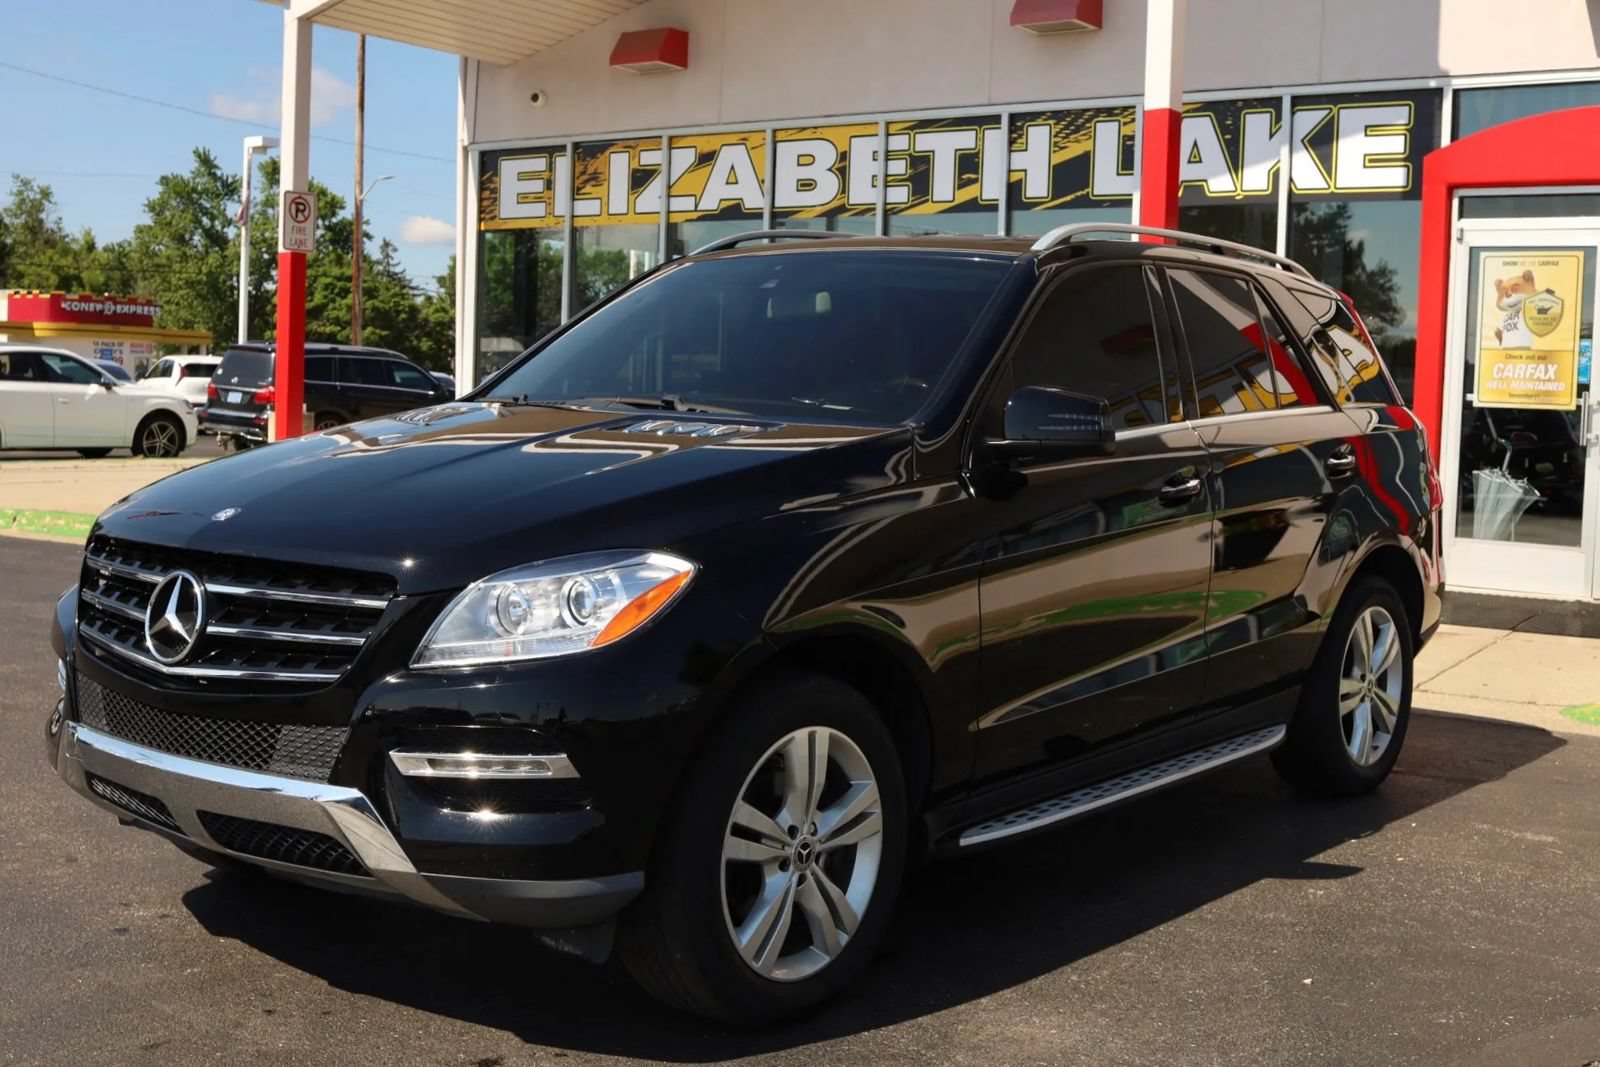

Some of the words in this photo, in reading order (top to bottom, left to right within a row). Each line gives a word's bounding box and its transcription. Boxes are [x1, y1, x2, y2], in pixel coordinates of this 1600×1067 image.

[499, 120, 1054, 220] ELIZABETH
[1090, 101, 1414, 199] LAKE
[290, 237, 307, 248] LANE
[64, 302, 102, 312] CONEY
[116, 305, 161, 315] EXPRESS
[1493, 363, 1558, 380] CARFAX
[1511, 381, 1565, 391] MAINTAINED
